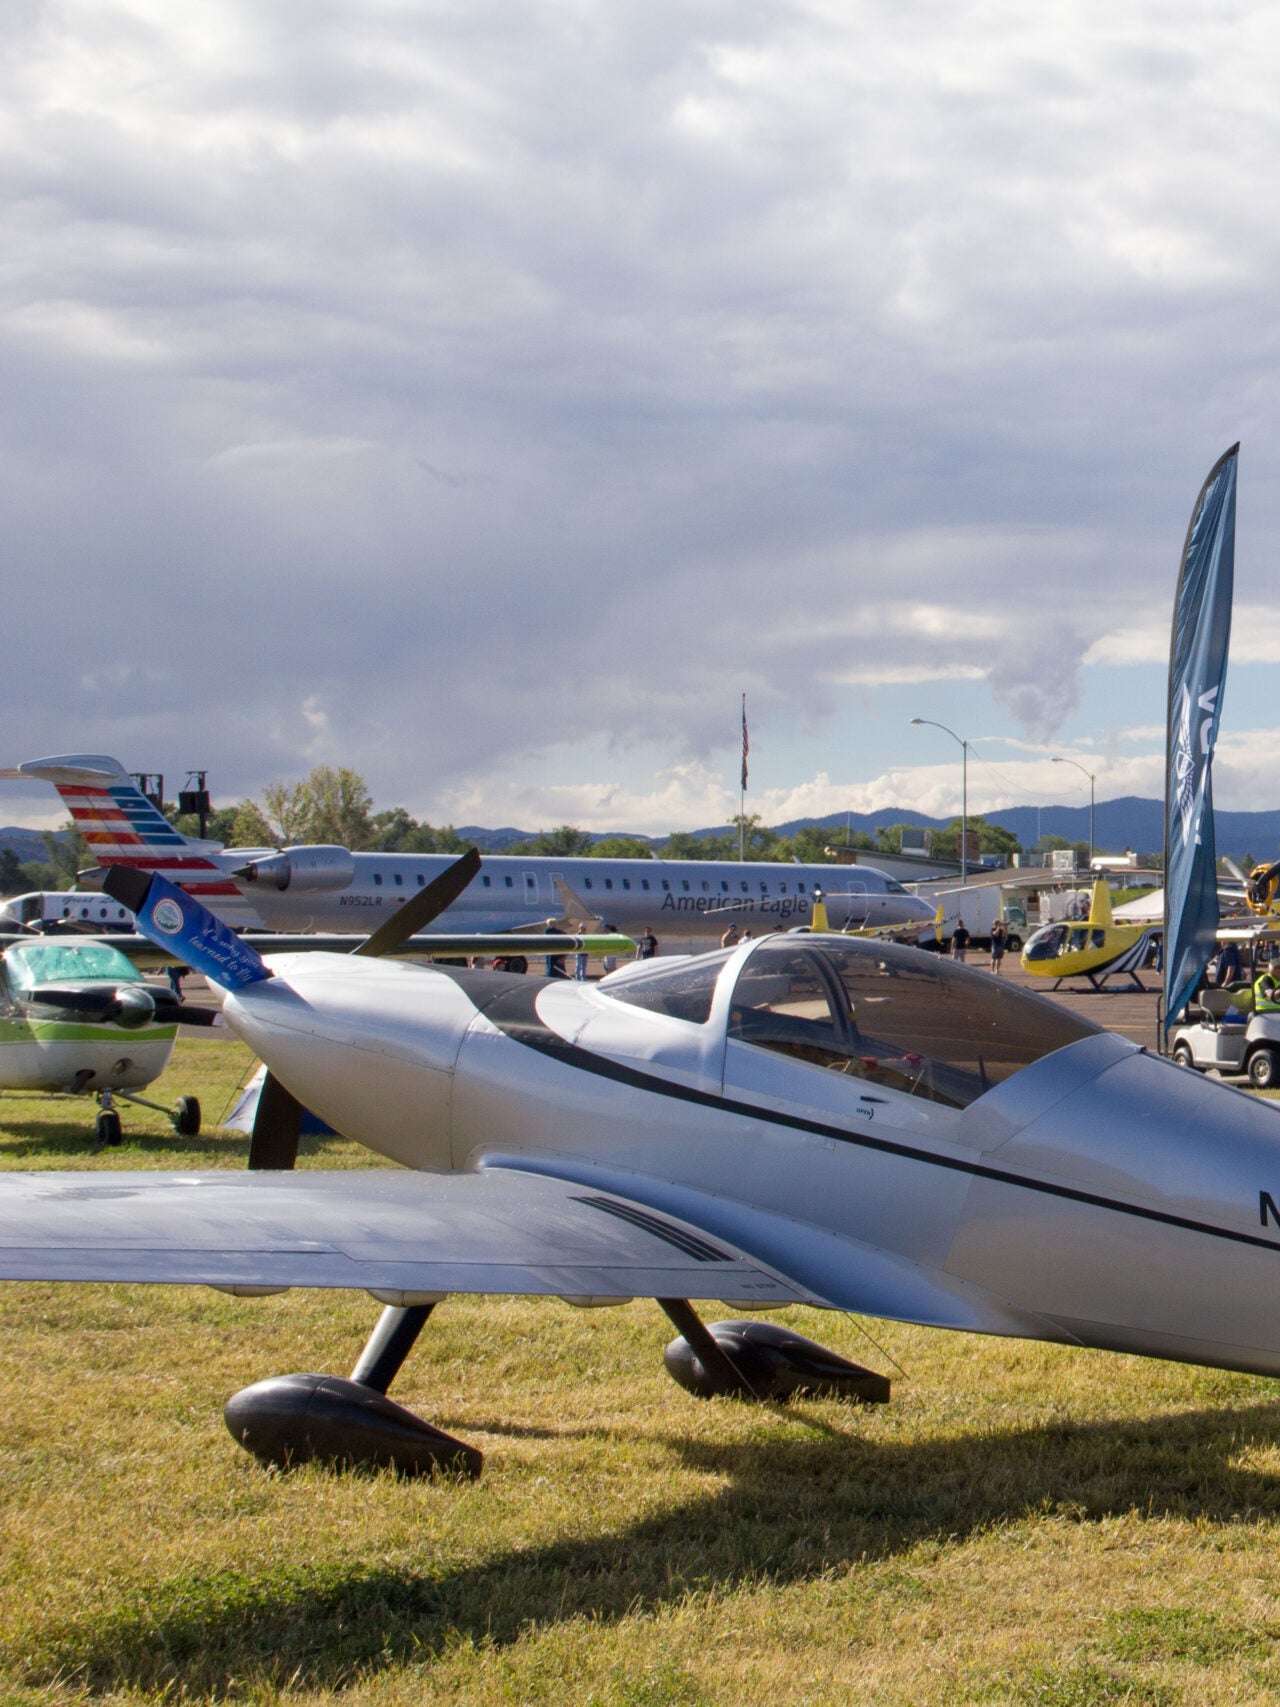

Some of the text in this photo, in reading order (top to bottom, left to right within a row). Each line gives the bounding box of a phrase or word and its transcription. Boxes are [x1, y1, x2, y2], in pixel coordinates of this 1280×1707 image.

[339, 895, 383, 907] N952LR
[660, 892, 809, 919] American Eagle
[188, 935, 232, 964] learned
